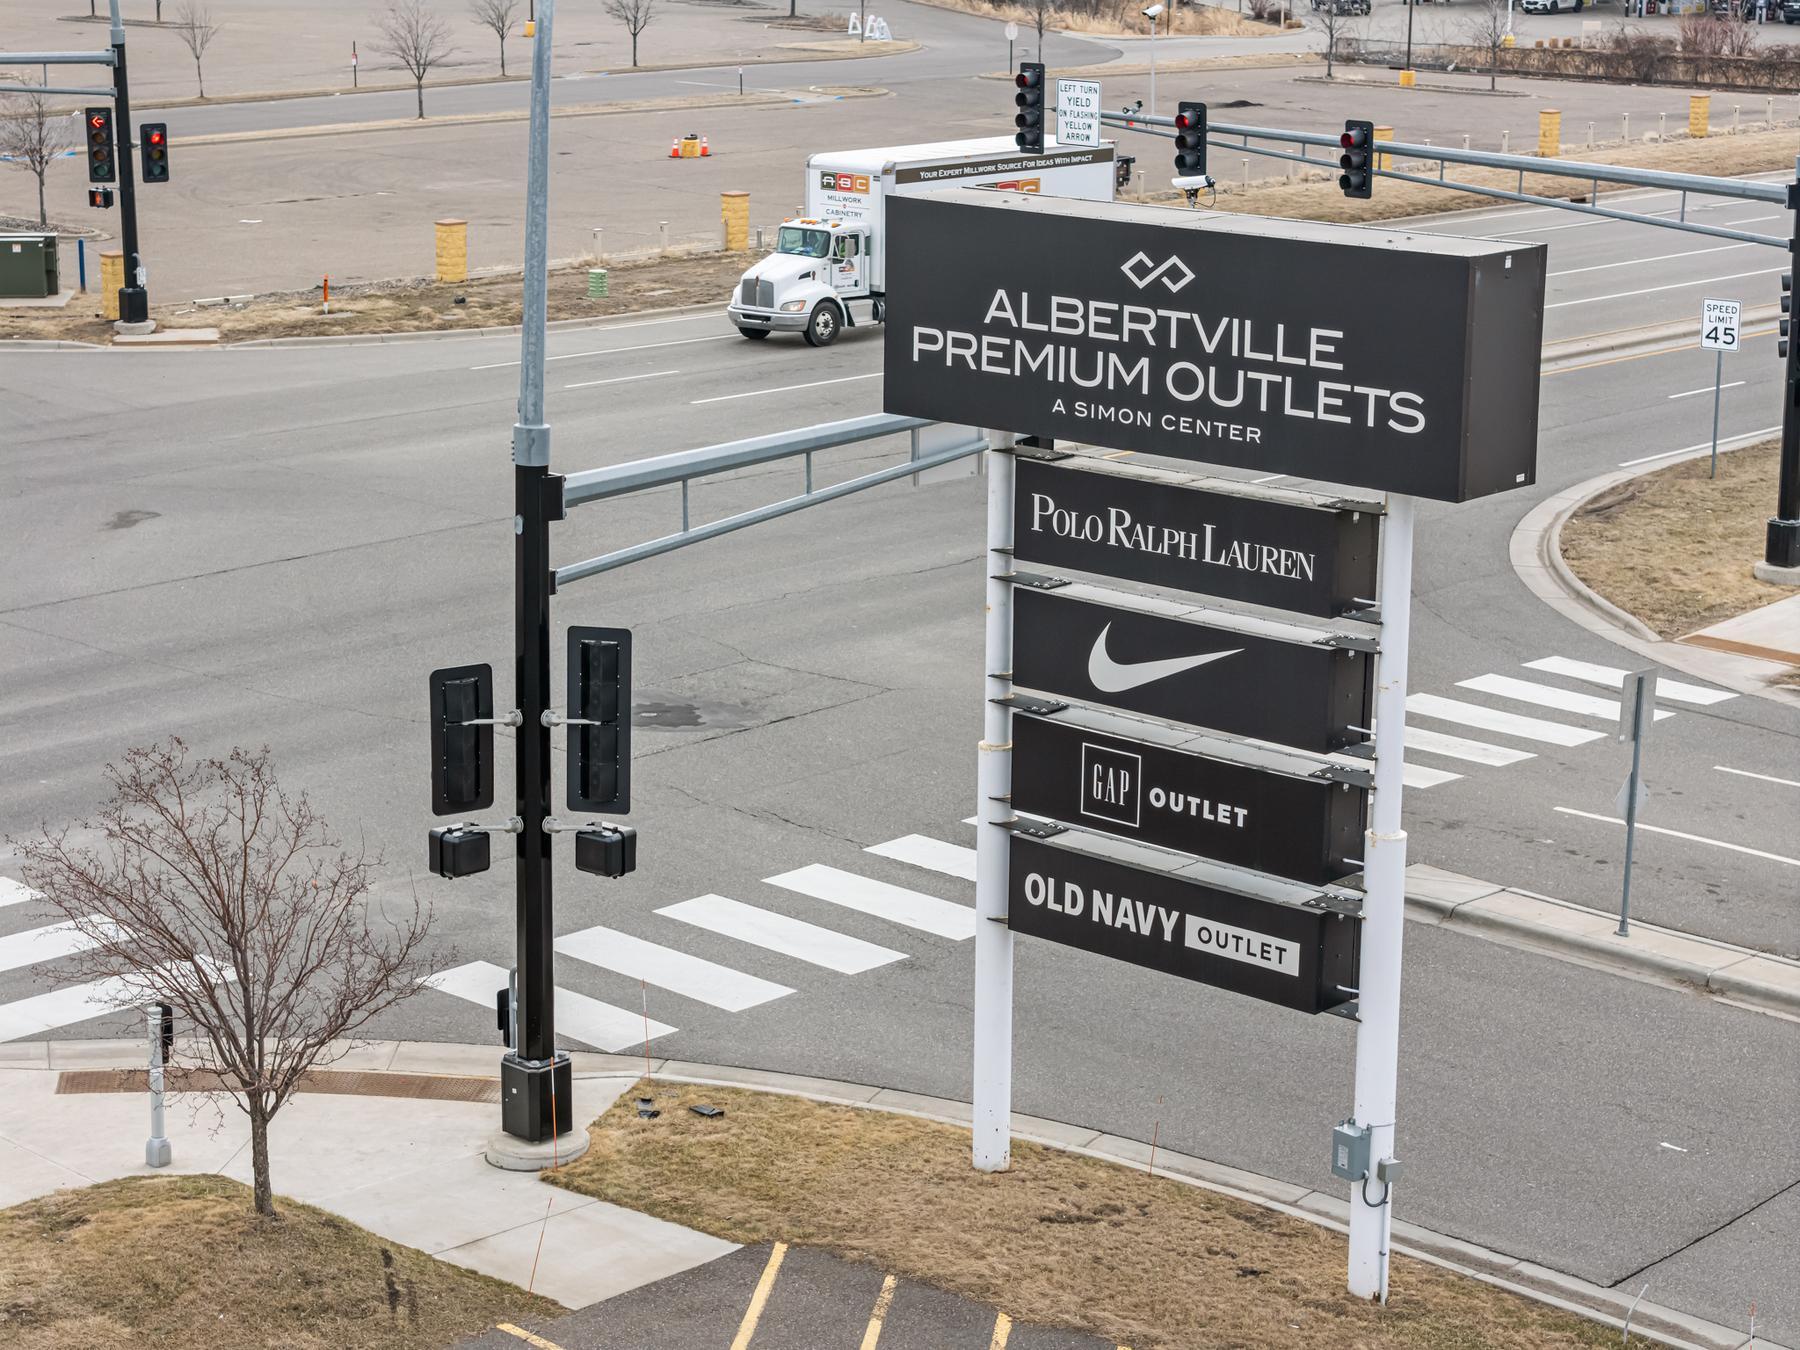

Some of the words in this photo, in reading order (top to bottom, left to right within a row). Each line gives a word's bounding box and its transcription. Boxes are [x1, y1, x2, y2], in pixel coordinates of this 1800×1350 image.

[1060, 84, 1076, 93] LEFT
[1079, 85, 1098, 94] TURN
[1067, 96, 1091, 107] YIELD
[1059, 109, 1067, 118] ON
[1069, 110, 1098, 120] FLASHING
[1064, 121, 1092, 131] YELLOW
[1065, 132, 1090, 142] ARROW
[822, 175, 868, 190] ABC
[827, 195, 862, 204] MILLWORK
[825, 208, 862, 218] CABINETRY
[1706, 304, 1738, 314] SPEED
[1708, 314, 1733, 325] LIMIT
[984, 289, 1344, 371] ALBERTVILLE
[1705, 326, 1736, 345] 45
[912, 325, 1149, 395] PREMIUM
[1165, 361, 1426, 434] OUTLETS
[1052, 398, 1066, 414] A
[1074, 401, 1151, 427] SIMON
[1161, 414, 1262, 443] CENTER
[1031, 493, 1103, 542] POLO
[1107, 507, 1198, 560] RALPH
[1202, 523, 1315, 582] LAUREN
[1092, 763, 1130, 806] GAP
[1149, 787, 1248, 828] OUTLET
[1024, 872, 1084, 917] OLD
[1092, 889, 1180, 942] NAVY
[1197, 926, 1287, 965] OUTLET
